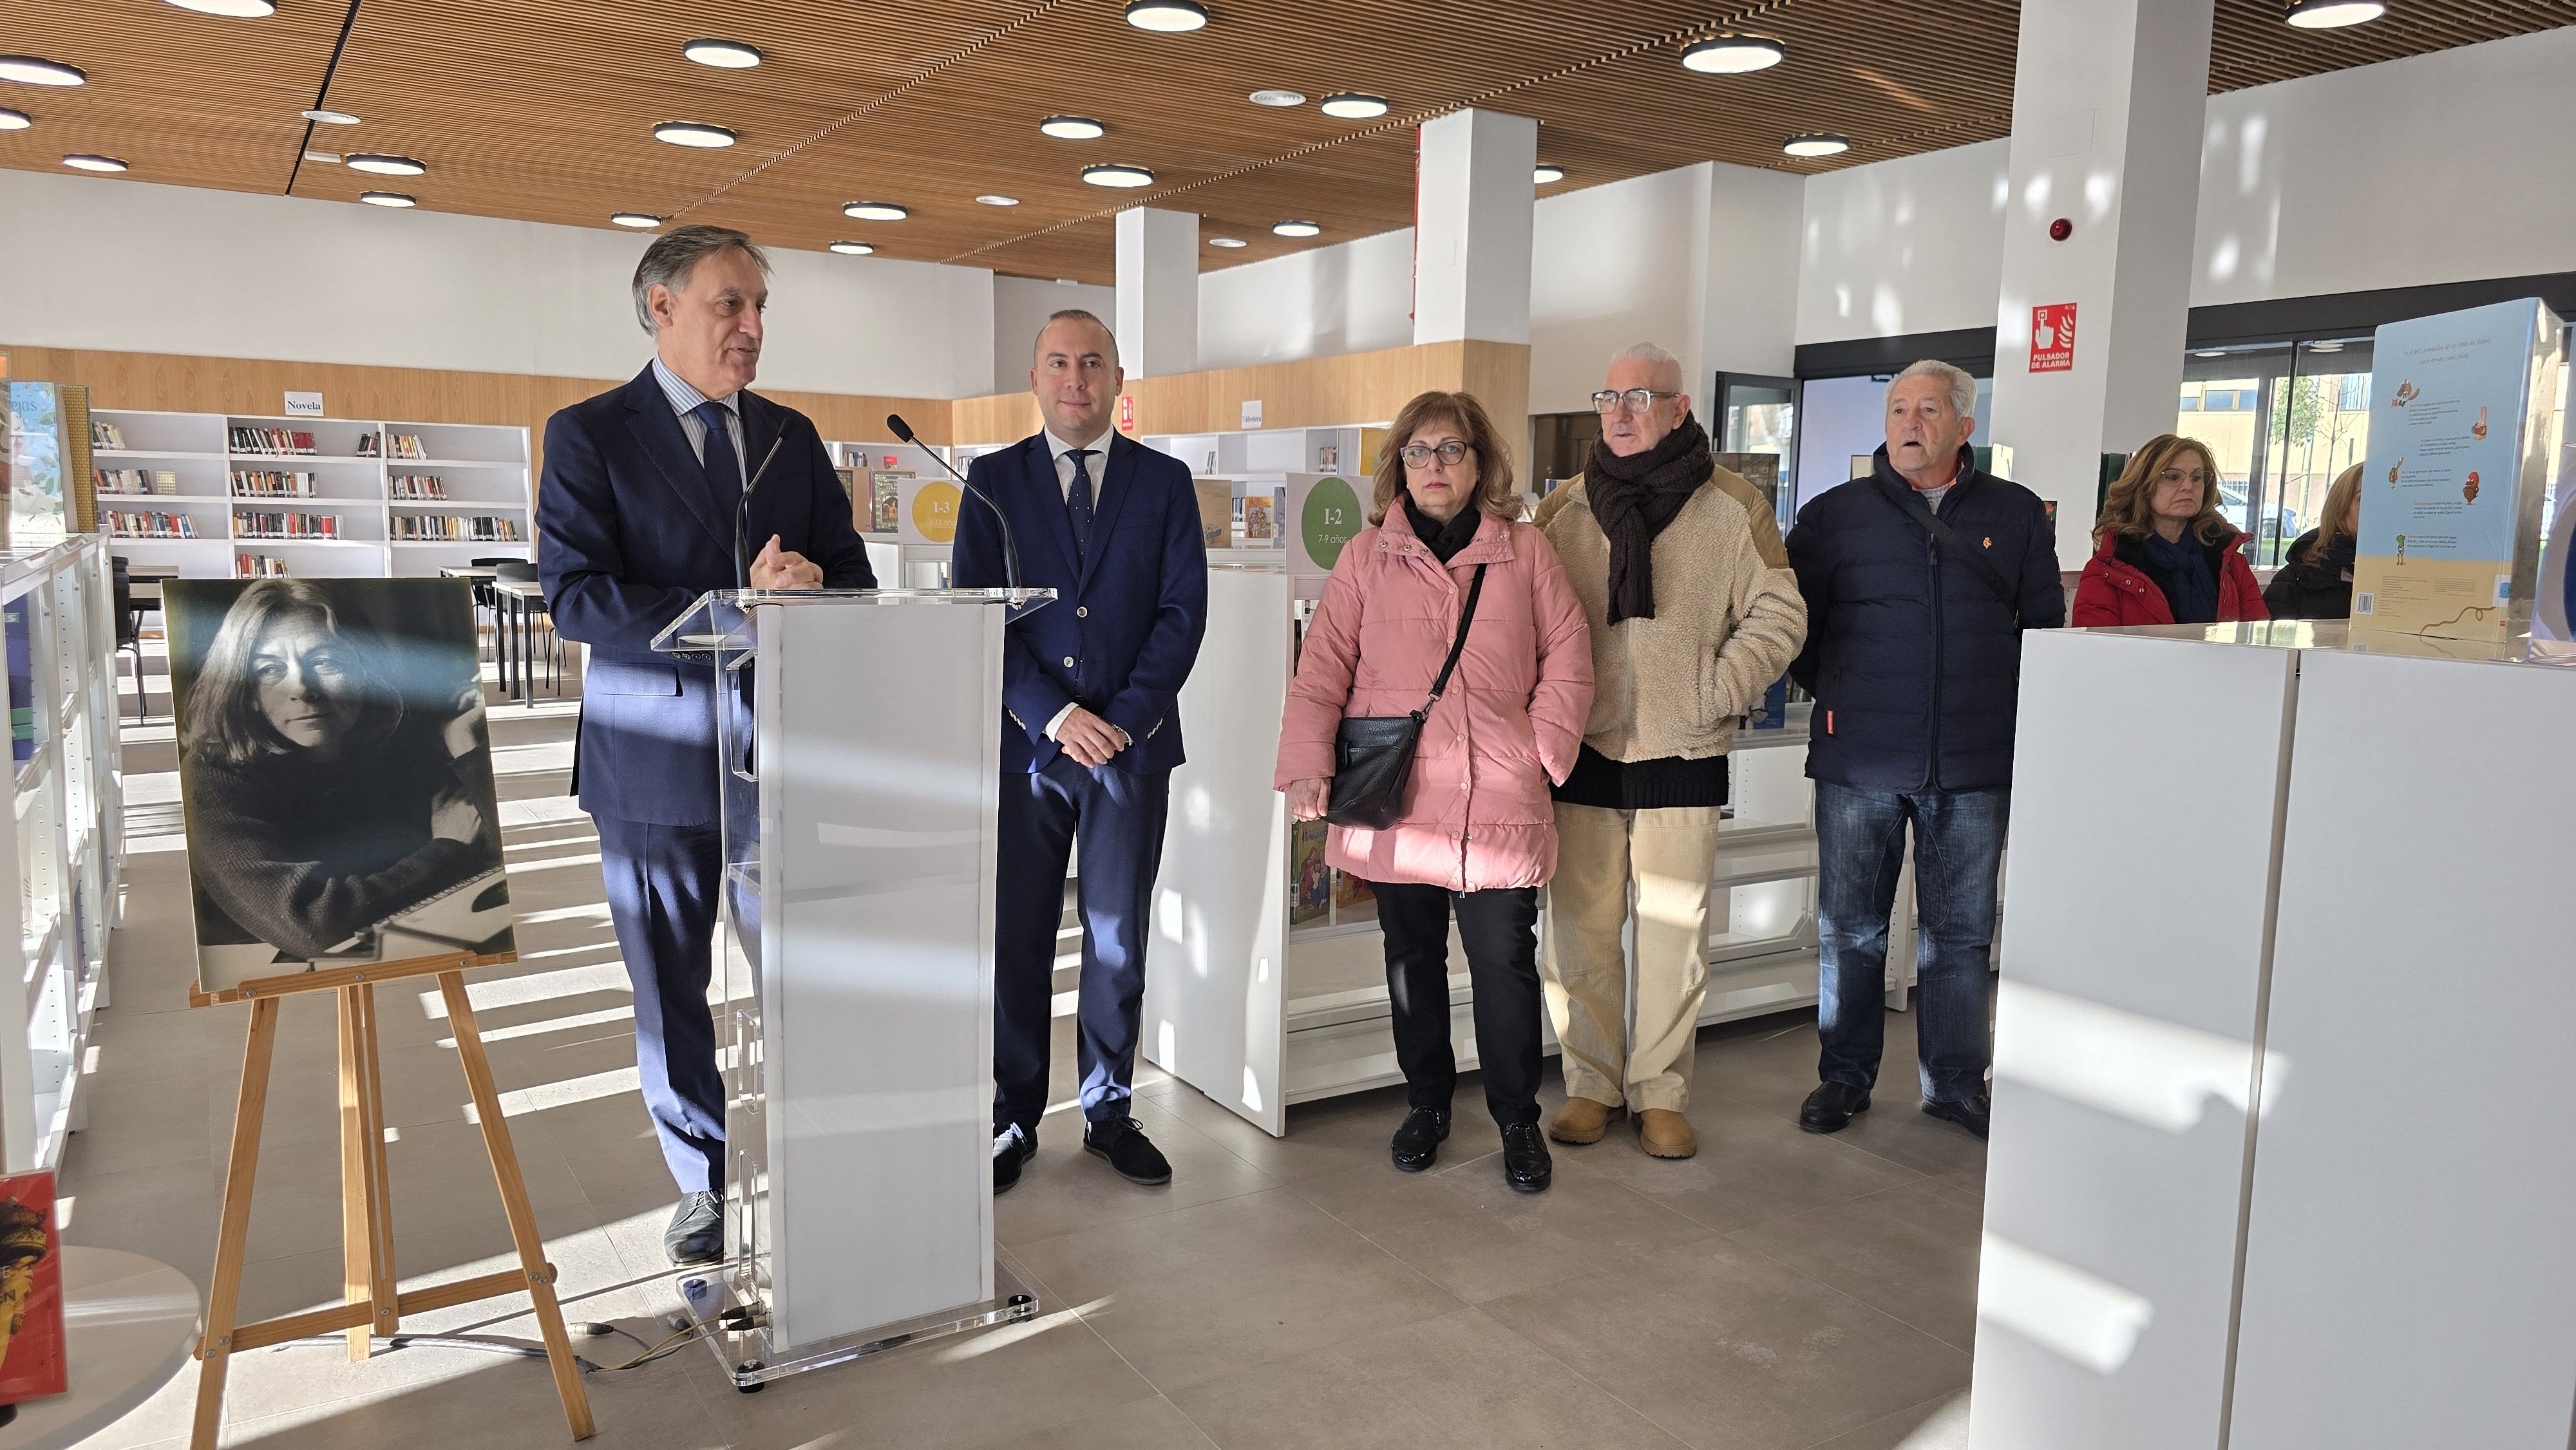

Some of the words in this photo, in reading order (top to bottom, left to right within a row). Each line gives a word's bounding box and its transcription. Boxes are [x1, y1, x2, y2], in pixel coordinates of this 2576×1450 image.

[2033, 352, 2070, 361] PULSADOR
[2041, 359, 2070, 368] ALARMA
[287, 400, 321, 410] Novela
[933, 502, 950, 513] I-3
[1324, 508, 1342, 525] I-2
[1318, 534, 1329, 543] 7-9
[1330, 534, 1347, 543] años
